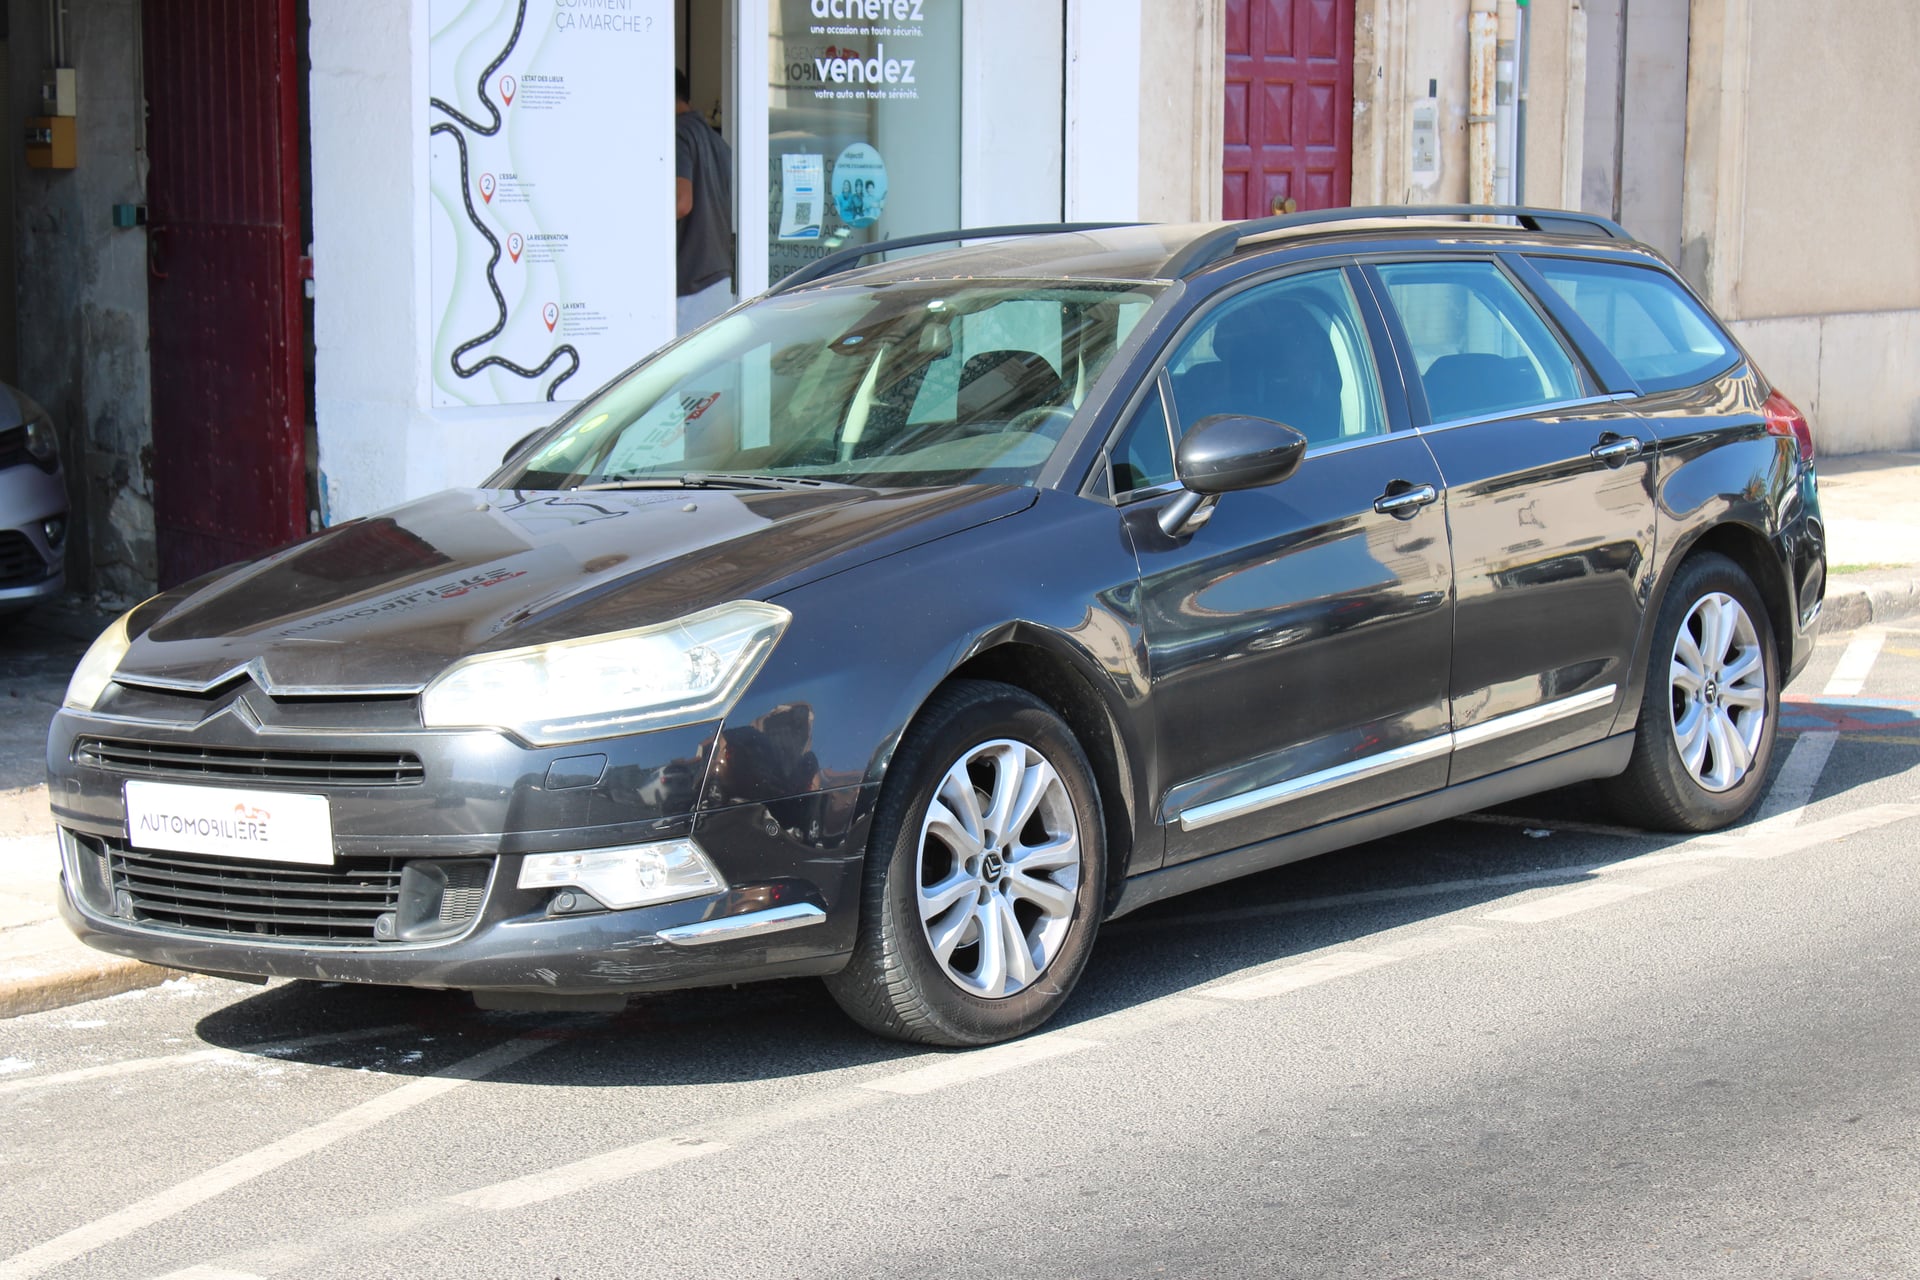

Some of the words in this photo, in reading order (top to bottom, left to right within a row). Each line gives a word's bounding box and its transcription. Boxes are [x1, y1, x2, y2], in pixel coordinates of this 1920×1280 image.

[811, 0, 924, 21] achetez
[555, 12, 576, 32] ÇA
[579, 14, 641, 32] MARCHE
[645, 16, 653, 32] ?
[810, 25, 825, 34] une
[826, 24, 859, 35] occasion
[860, 27, 869, 35] en
[871, 26, 891, 36] toute
[815, 43, 915, 83] vendez
[815, 90, 834, 99] votre
[836, 90, 854, 99] auto
[855, 91, 865, 99] en
[867, 90, 887, 99] toute
[484, 178, 491, 190] 2
[512, 237, 519, 249] 3
